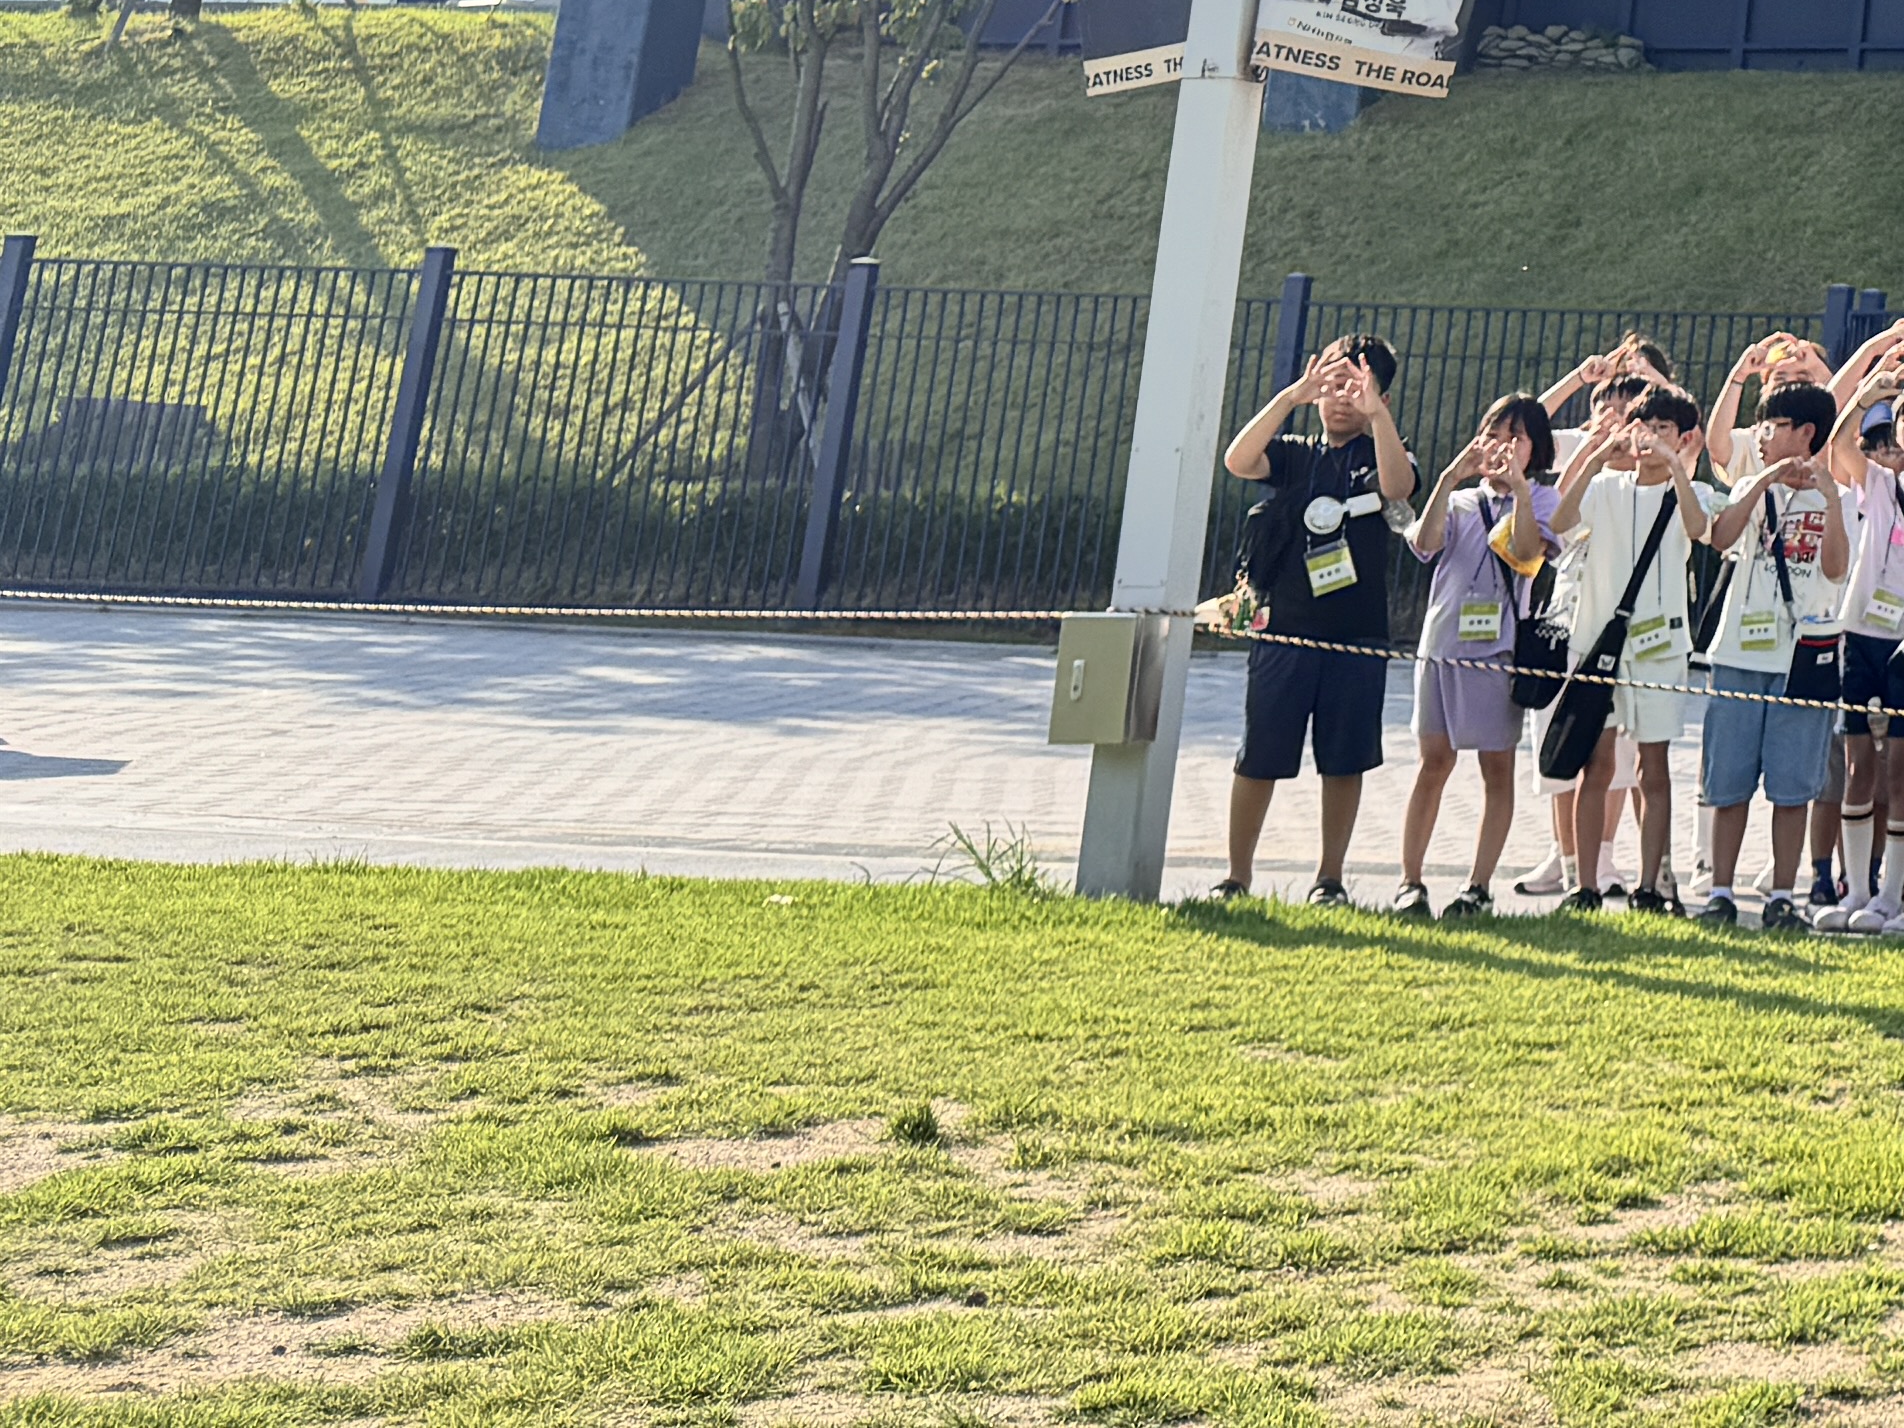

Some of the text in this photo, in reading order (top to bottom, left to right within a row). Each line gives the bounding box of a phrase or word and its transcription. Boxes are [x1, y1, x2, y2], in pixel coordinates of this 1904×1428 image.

[1252, 41, 1342, 71] ATNESS
[1354, 60, 1397, 82] THE
[1086, 62, 1153, 88] ATNESS
[1764, 562, 1812, 578] LODON
